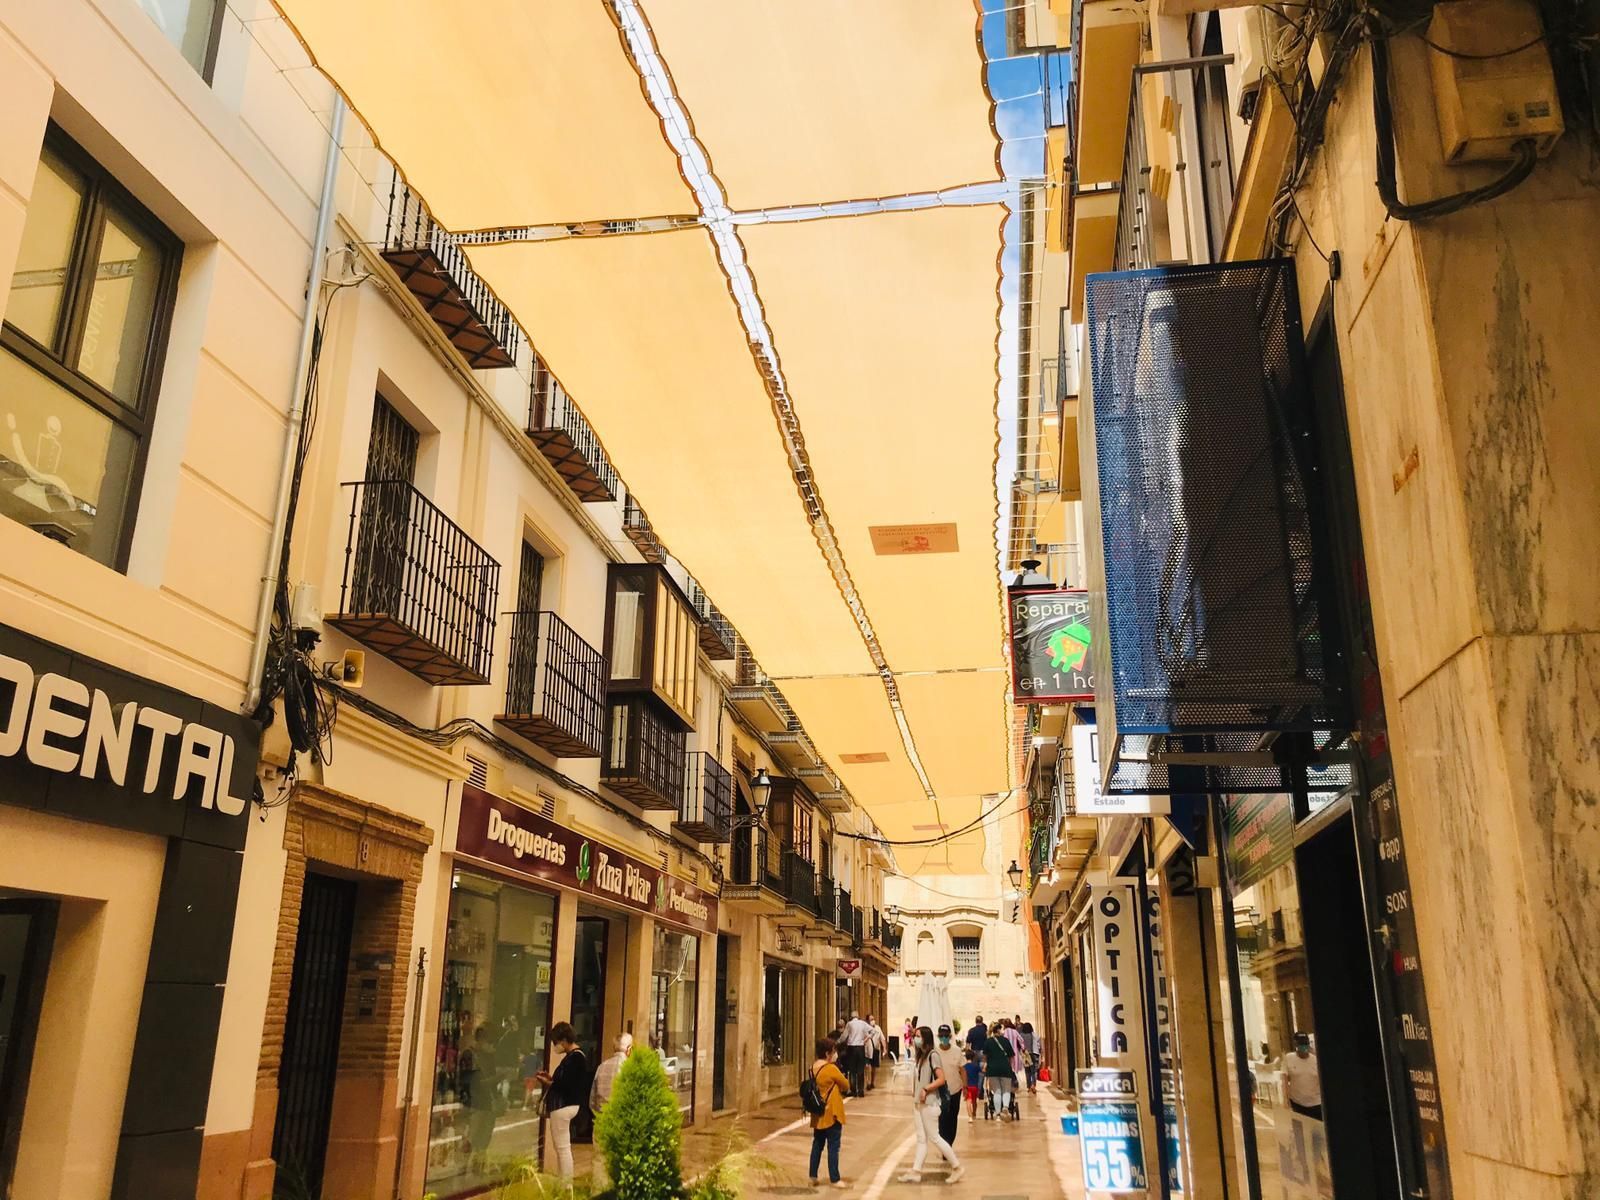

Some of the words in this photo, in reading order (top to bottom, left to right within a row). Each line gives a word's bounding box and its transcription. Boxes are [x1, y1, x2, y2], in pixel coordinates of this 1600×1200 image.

[1020, 677, 1046, 690] en
[1052, 672, 1061, 689] 1
[0, 654, 246, 816] DENTAL
[1094, 797, 1126, 806] Estado
[487, 808, 566, 866] Droguerías
[596, 852, 622, 895] Ana
[624, 863, 651, 904] Pilar
[1386, 890, 1408, 914] SON
[1100, 890, 1128, 1053] ÓPTICA
[1082, 1075, 1132, 1092] ÓPTICA
[1083, 1121, 1138, 1138] REBAJAS
